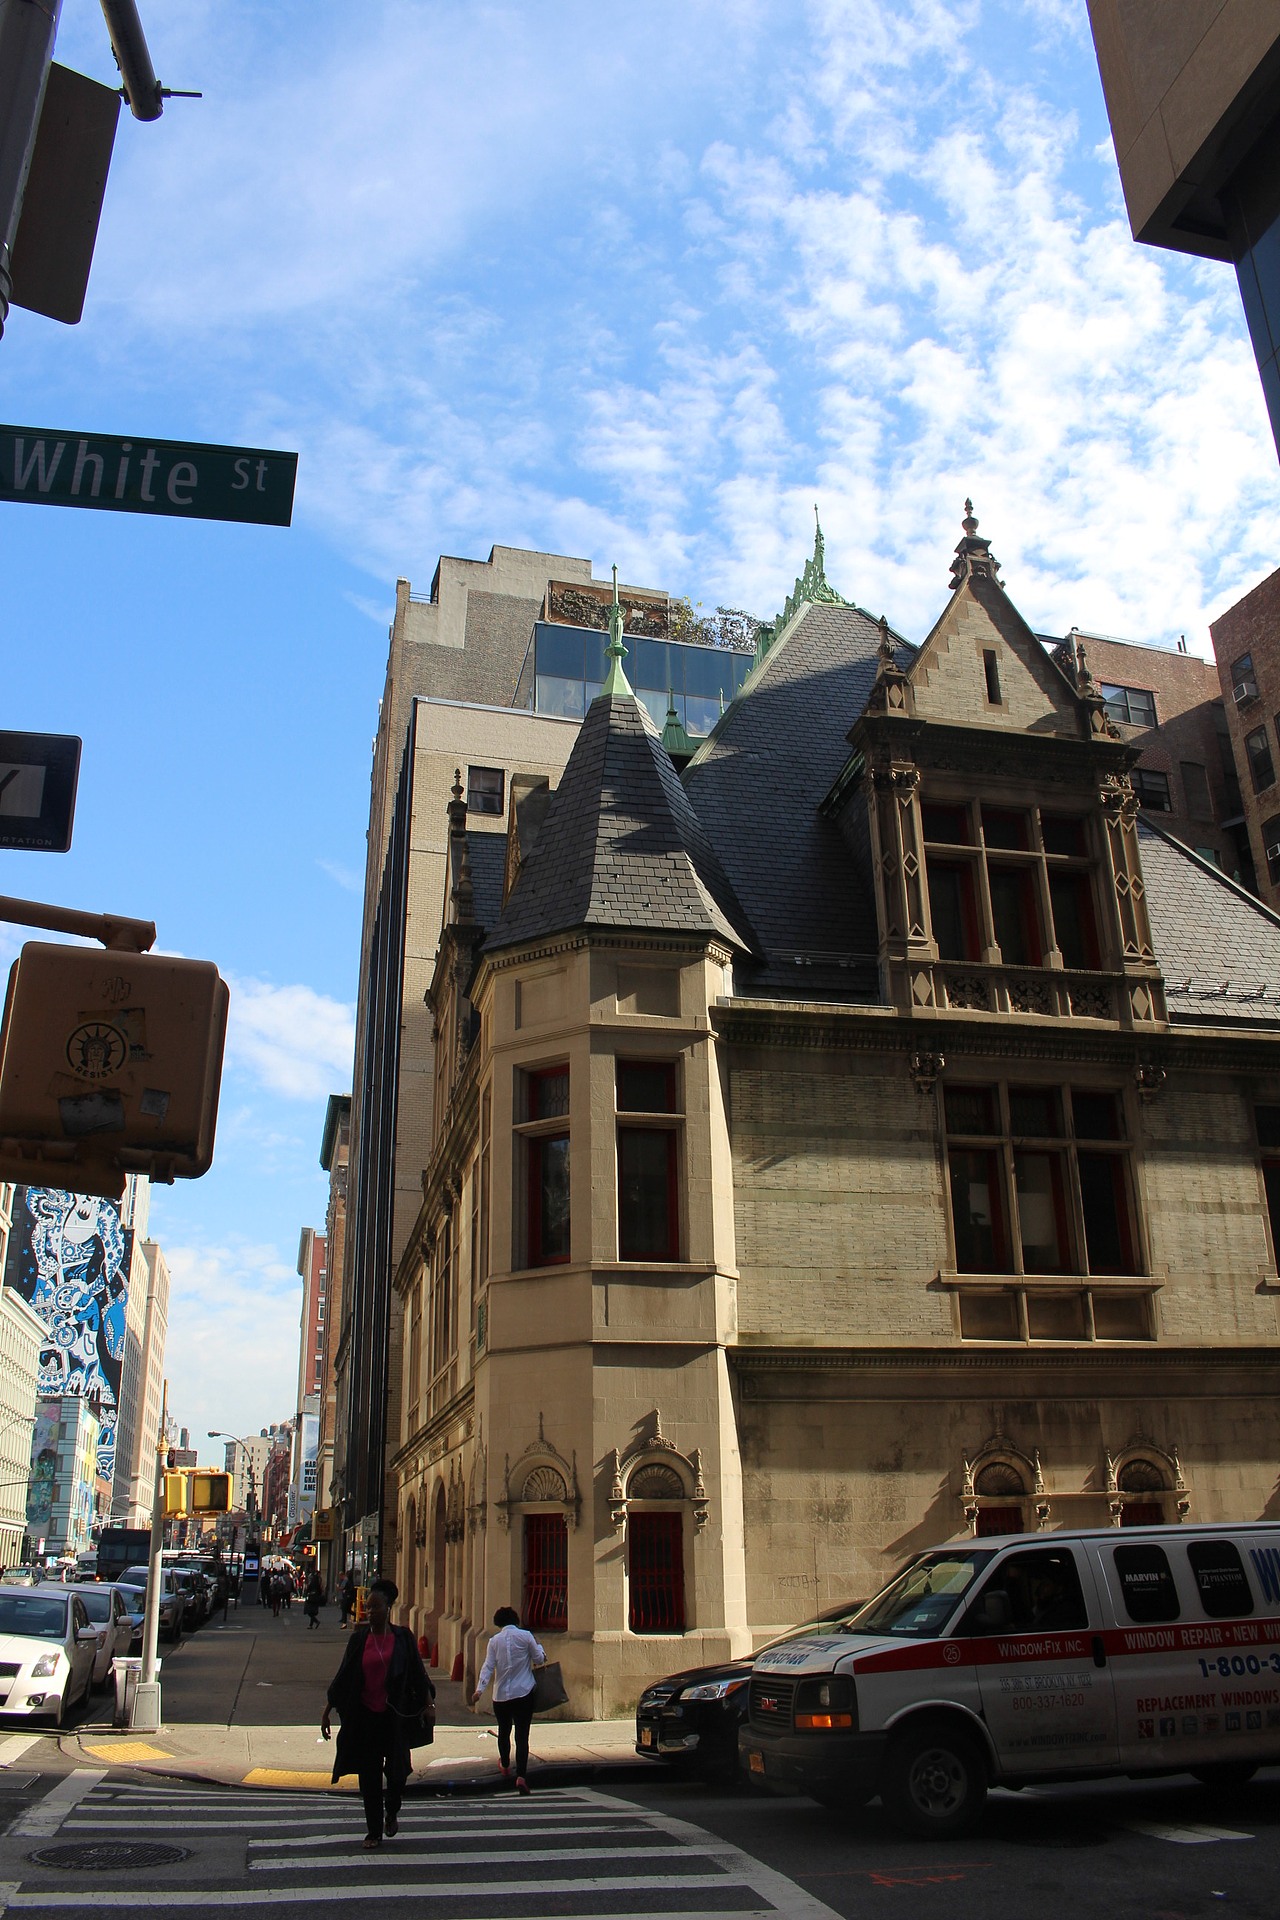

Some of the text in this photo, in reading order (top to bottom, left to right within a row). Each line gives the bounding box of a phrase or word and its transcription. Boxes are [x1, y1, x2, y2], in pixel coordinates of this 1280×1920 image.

[13, 437, 269, 505] White St
[0, 836, 53, 846] RTATION
[75, 1066, 114, 1079] RESIST
[1125, 1572, 1159, 1582] MARVIN
[1124, 1630, 1175, 1650] WINDOW
[1181, 1627, 1224, 1646] REPAIR
[1232, 1624, 1259, 1642] NEW
[946, 1647, 958, 1660] 25
[1013, 1693, 1084, 1711] 800-337-1620
[1137, 1689, 1279, 1713] REPLACEMENT WINDOWS
